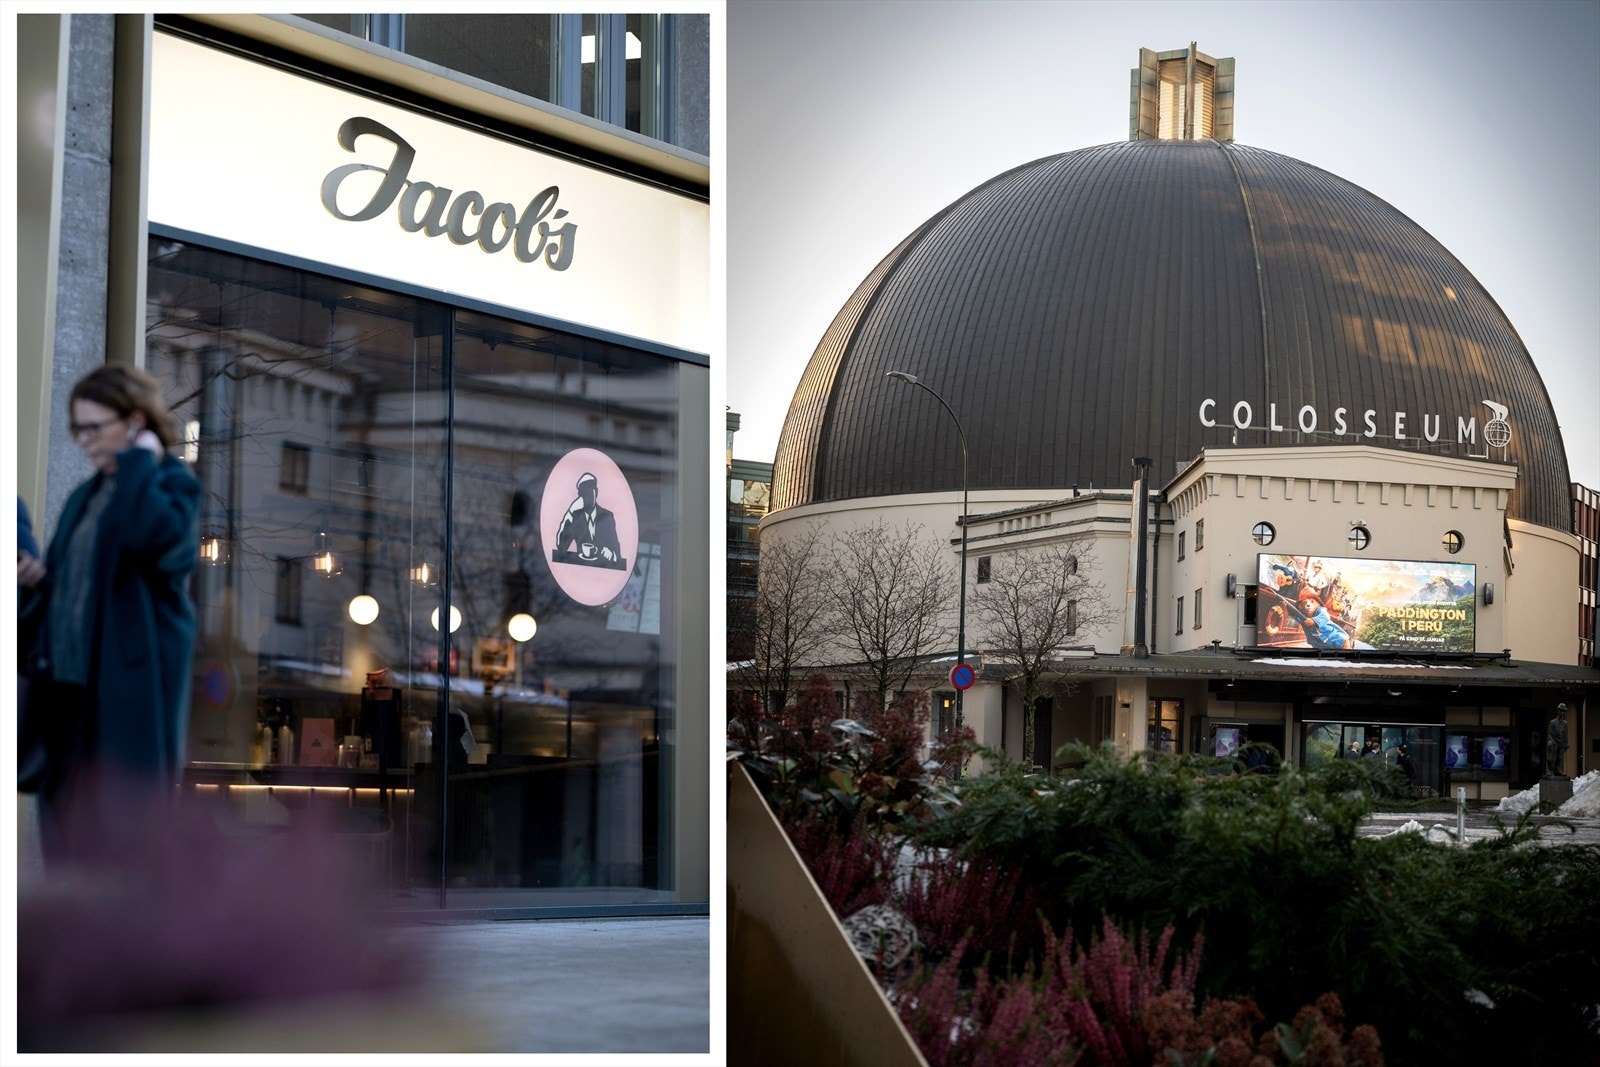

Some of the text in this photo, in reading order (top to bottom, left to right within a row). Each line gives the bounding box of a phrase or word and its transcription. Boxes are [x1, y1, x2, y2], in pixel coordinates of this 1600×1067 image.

[320, 116, 578, 271] Jacob's
[1199, 398, 1475, 444] COLOSSEUM
[1408, 620, 1443, 632] PERU
